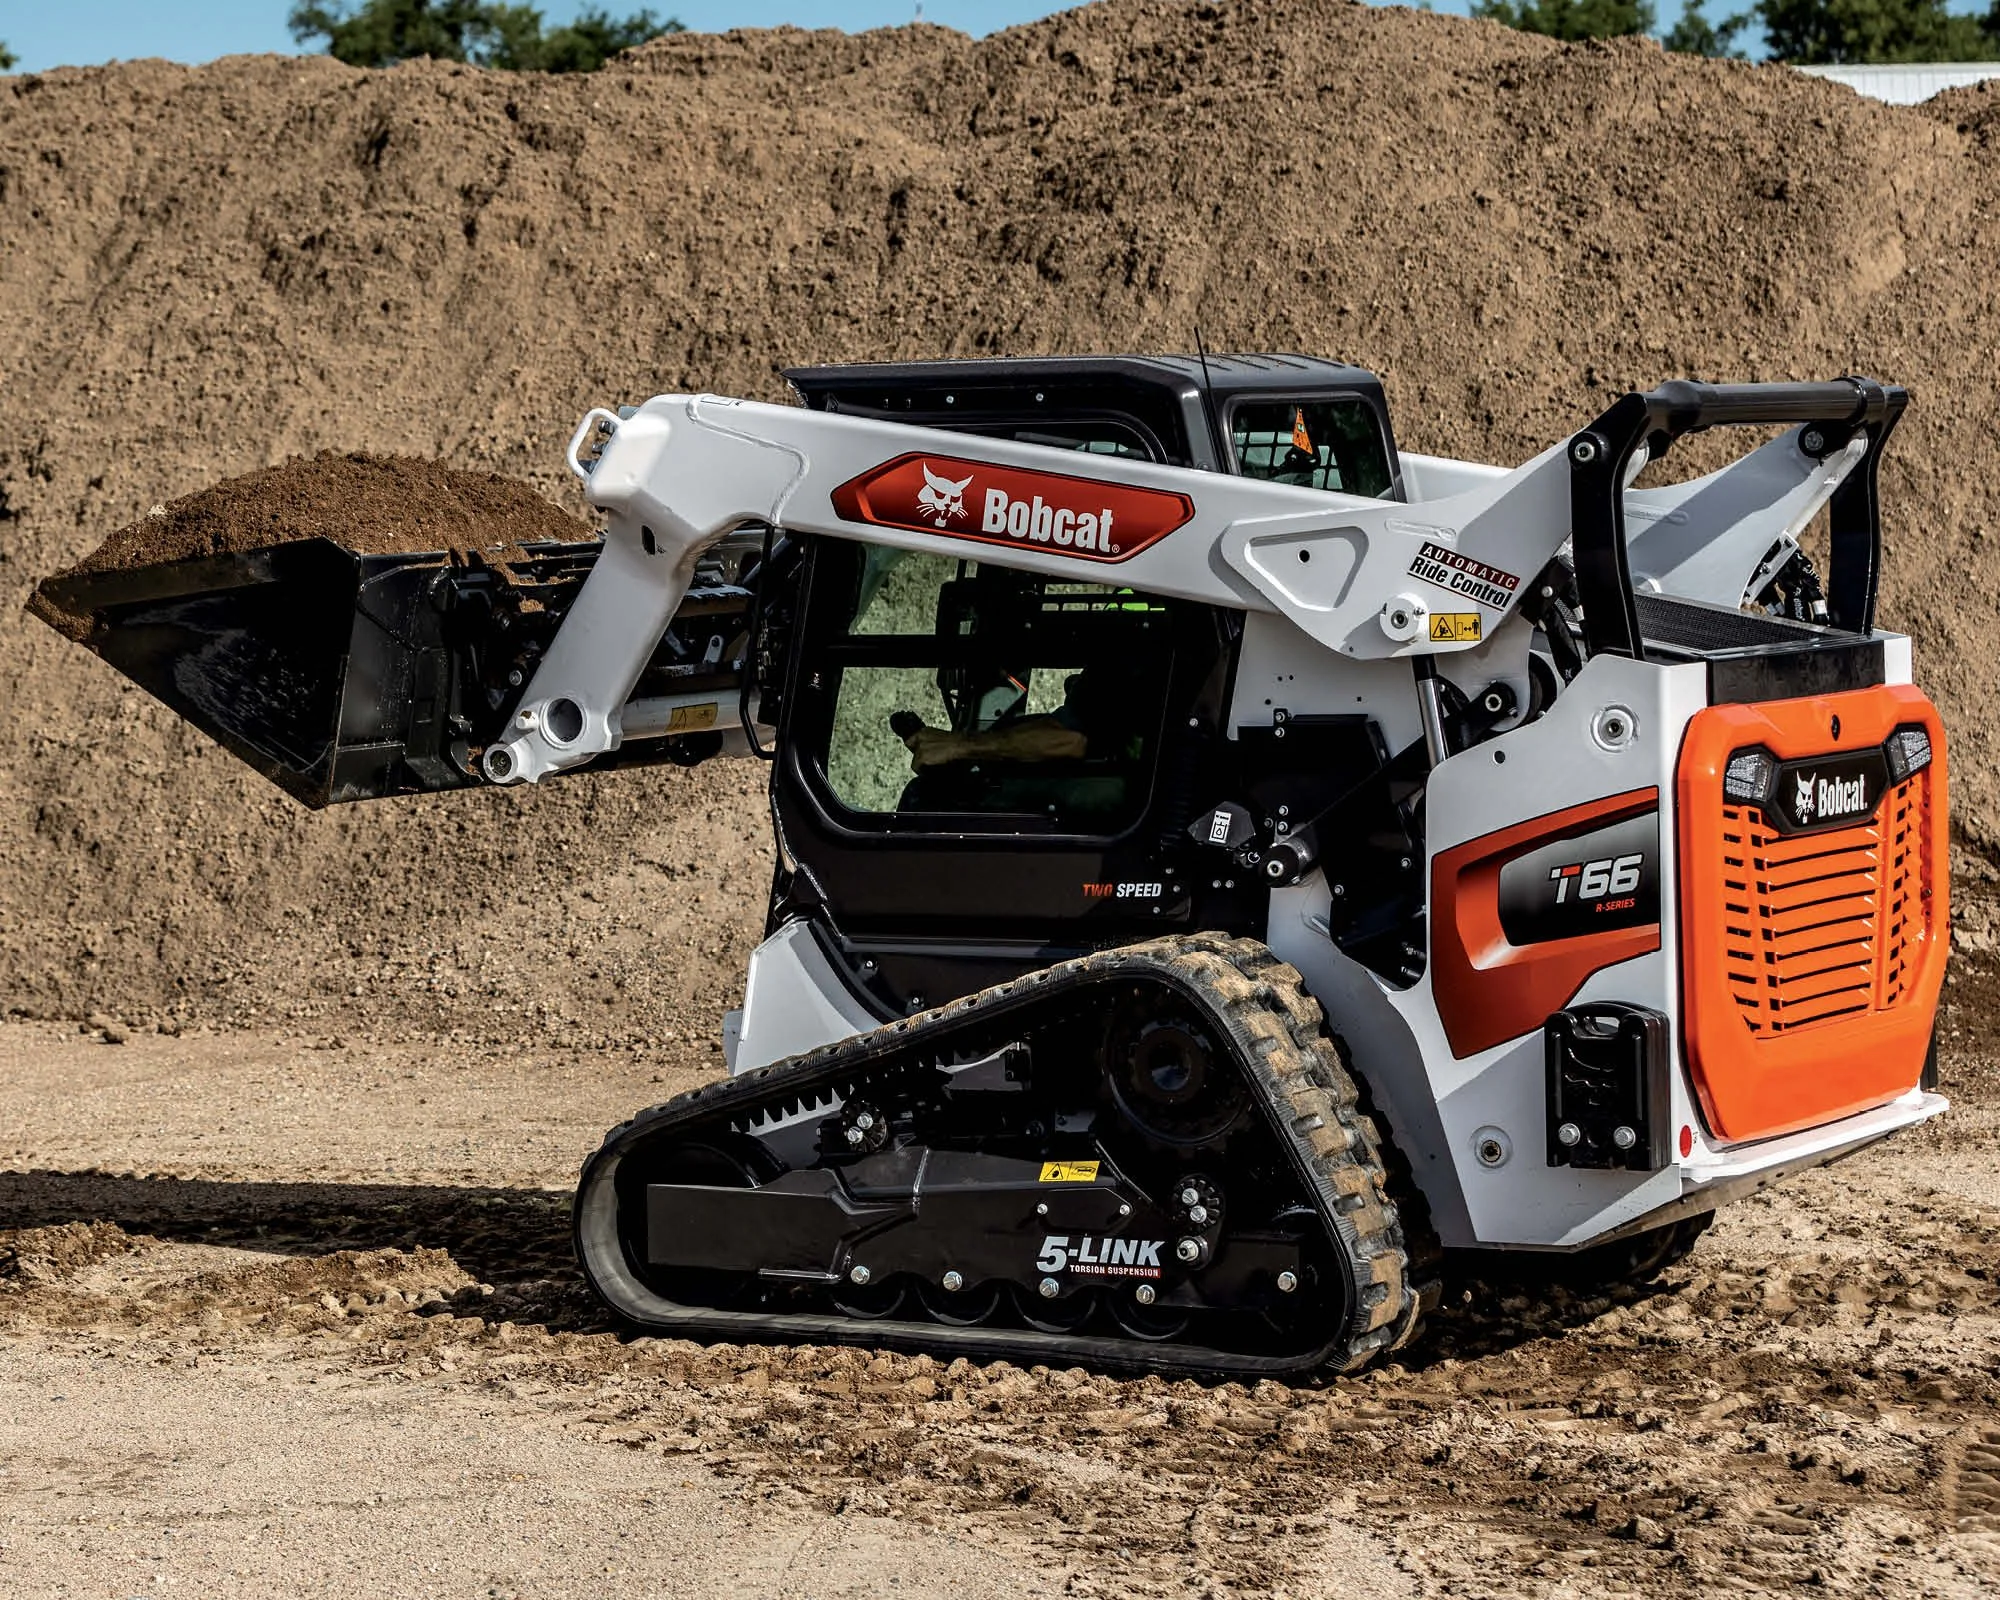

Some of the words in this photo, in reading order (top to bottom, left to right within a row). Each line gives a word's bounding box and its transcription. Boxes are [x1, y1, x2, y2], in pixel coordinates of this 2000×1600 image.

[1410, 556, 1448, 583] Ride
[1450, 572, 1512, 608] Control
[1423, 545, 1516, 588] AUTOMATIC
[1818, 774, 1866, 817] Bobcat
[1082, 883, 1113, 897] TWO
[1116, 883, 1162, 897] SPEED
[1551, 854, 1643, 904] T66
[1596, 898, 1635, 912] R-SERIES
[1036, 1235, 1165, 1273] 5-LINK
[1070, 1264, 1105, 1274] TORSION
[1108, 1266, 1159, 1277] SUSPENSION
